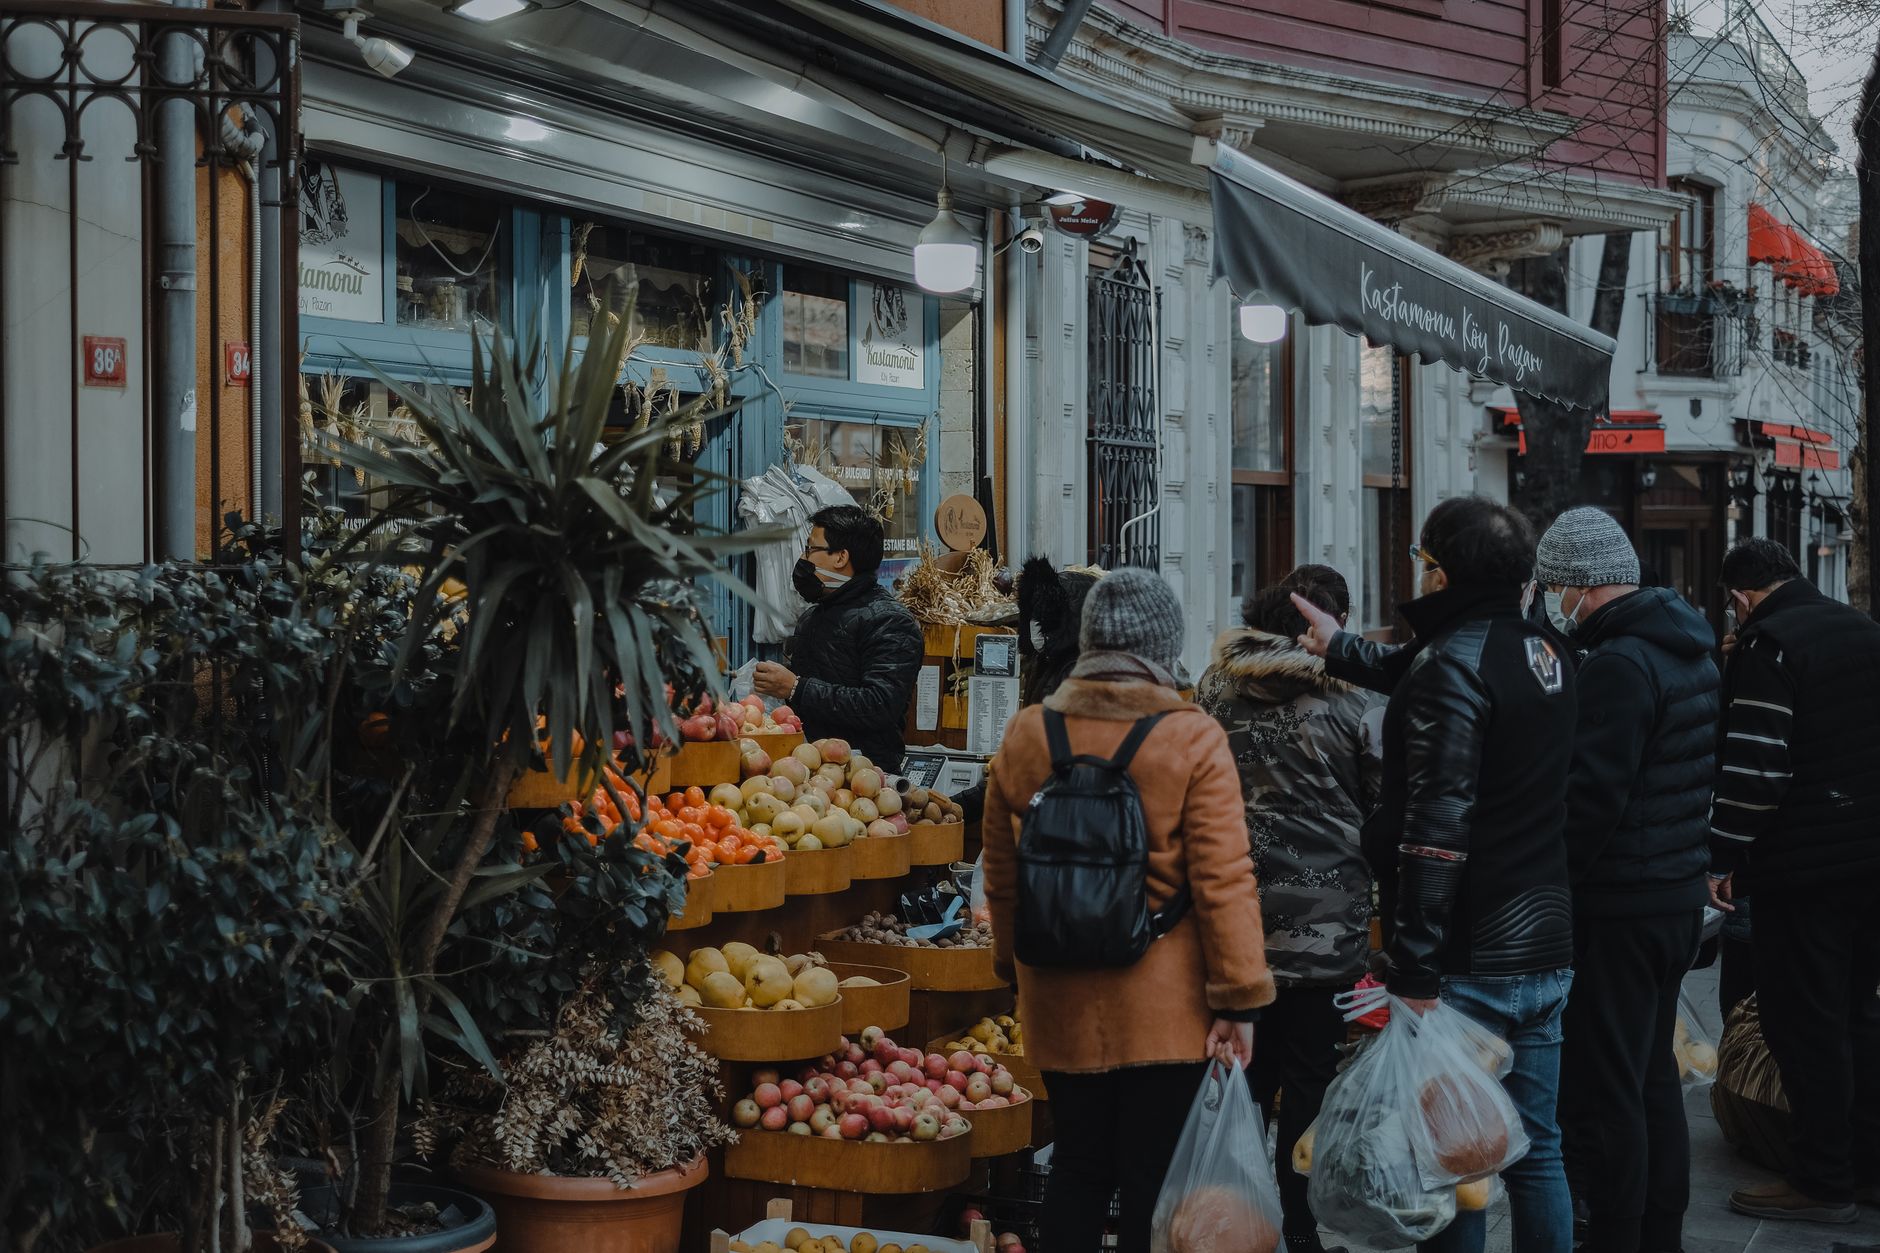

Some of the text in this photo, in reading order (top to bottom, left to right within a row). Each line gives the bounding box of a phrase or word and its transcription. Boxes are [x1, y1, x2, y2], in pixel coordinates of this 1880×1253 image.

[1058, 216, 1080, 224] Julius
[298, 261, 364, 296] tamonu
[1360, 260, 1457, 341] Kastamonu
[1461, 305, 1493, 374] Köy
[865, 344, 916, 371] Kastamonu
[883, 538, 906, 552] ESTANE
